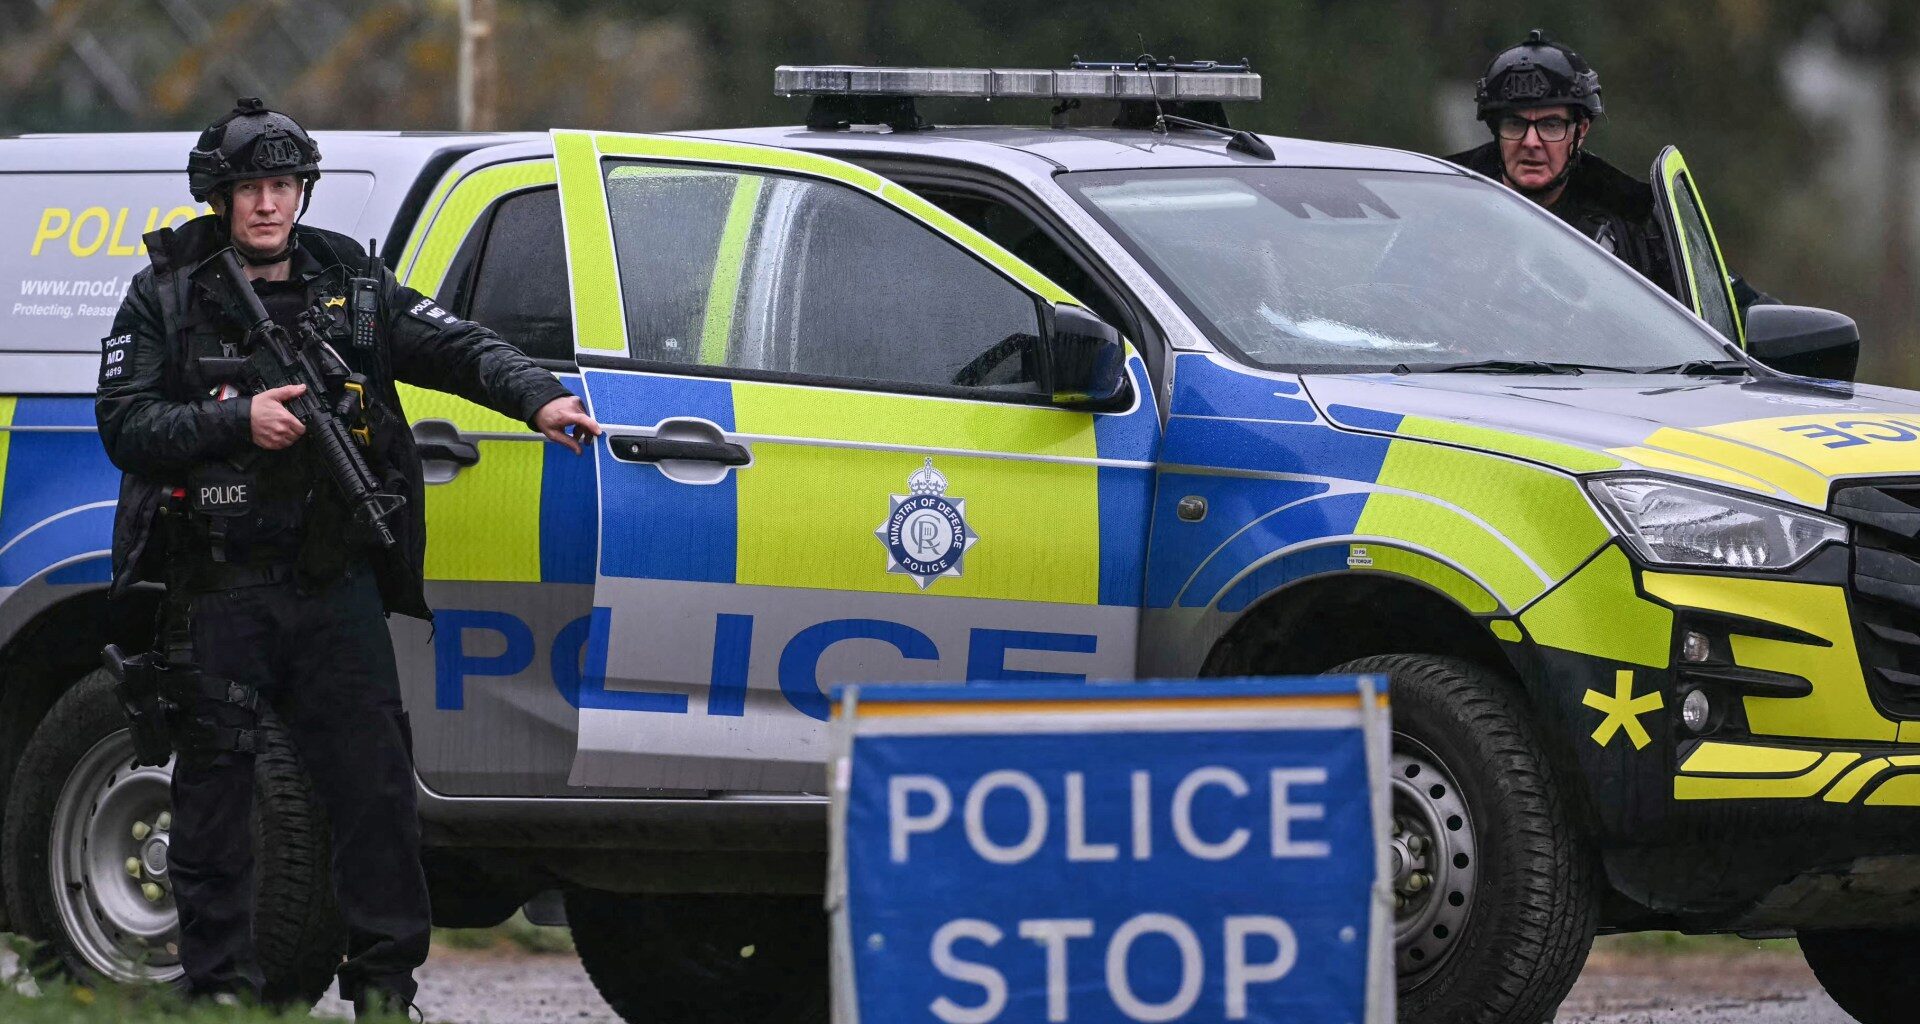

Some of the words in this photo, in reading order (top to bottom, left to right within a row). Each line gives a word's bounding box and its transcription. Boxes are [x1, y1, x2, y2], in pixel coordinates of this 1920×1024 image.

[31, 206, 216, 258] POLI
[426, 307, 446, 319] MD
[106, 334, 132, 350] POLICE
[106, 350, 125, 365] MD
[201, 484, 248, 506] POLICE
[890, 499, 918, 546] MINISTRY
[920, 497, 936, 507] OF
[937, 501, 963, 549] DEFENCE
[902, 557, 948, 573] POLICE
[888, 766, 1331, 865] POLICE
[928, 912, 1298, 1024] STOP
